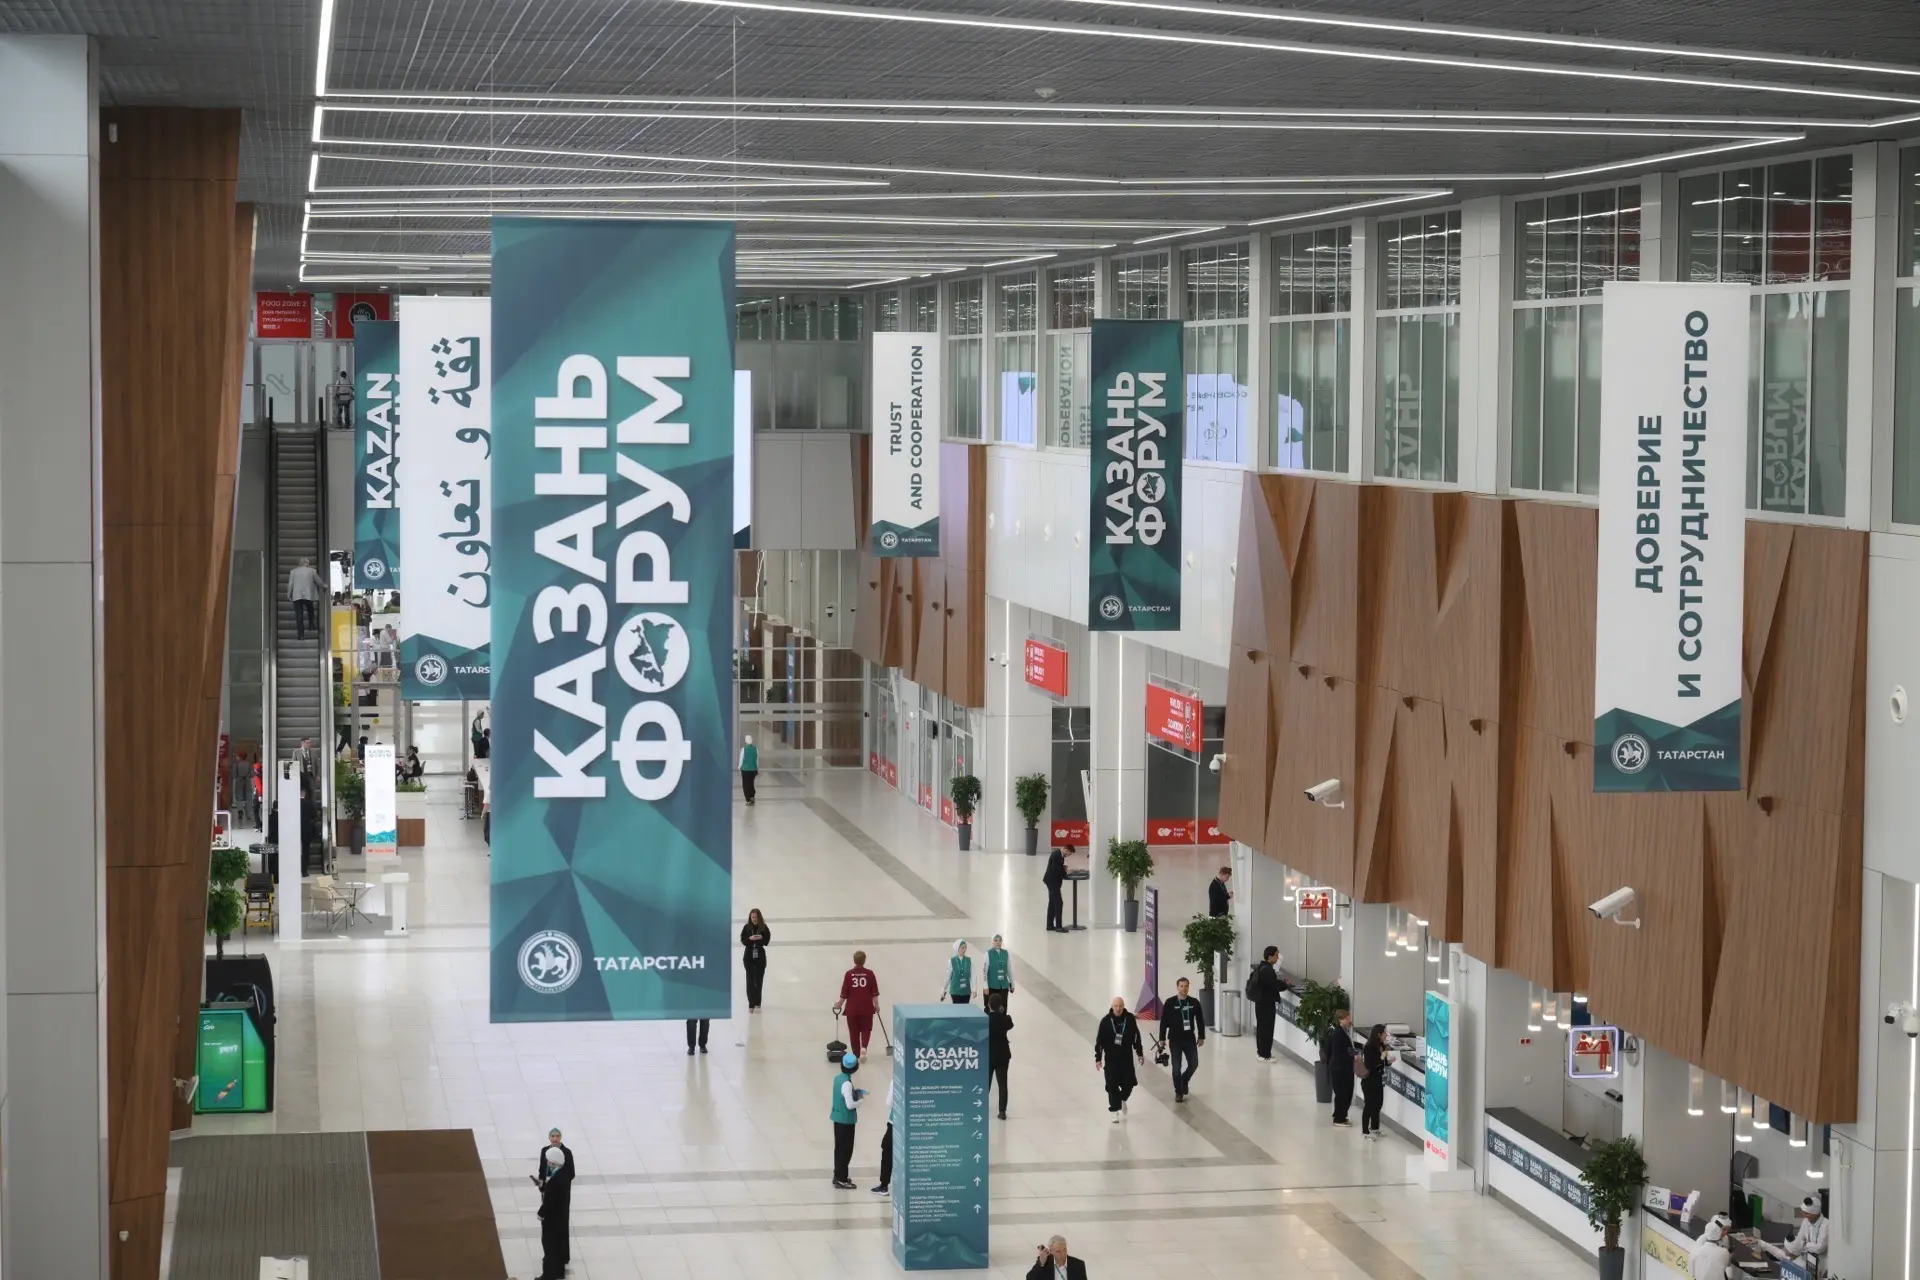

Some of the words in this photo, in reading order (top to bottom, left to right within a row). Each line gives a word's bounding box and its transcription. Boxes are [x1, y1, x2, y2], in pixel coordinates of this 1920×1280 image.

[430, 336, 480, 408] ثقة
[890, 402, 902, 455] TRUST
[910, 345, 923, 468] COOPERATION
[366, 373, 393, 509] KAZAN
[456, 428, 491, 460] و
[1105, 371, 1135, 545] КАЗАНЬ
[1135, 372, 1167, 546] ФОРУМ
[910, 472, 923, 510] AND
[1635, 415, 1663, 593] ДОВЕРИЕ
[1677, 310, 1709, 662] СОТРУДНИЧЕСТВО
[438, 479, 491, 608] تعاون
[533, 353, 608, 798] КАЗАНЬ
[612, 356, 691, 801] ФОРУМ
[1677, 673, 1701, 698] И
[1657, 750, 1725, 760] ТАТАРСТАН
[594, 955, 705, 970] ТАТАРСТАН
[852, 977, 867, 988] 30
[914, 1046, 979, 1060] КАЗАНЬ
[914, 1058, 979, 1072] ФОРУМ
[1426, 1045, 1448, 1067] КАЗАНЬ
[1426, 1056, 1448, 1080] ФОРУМ
